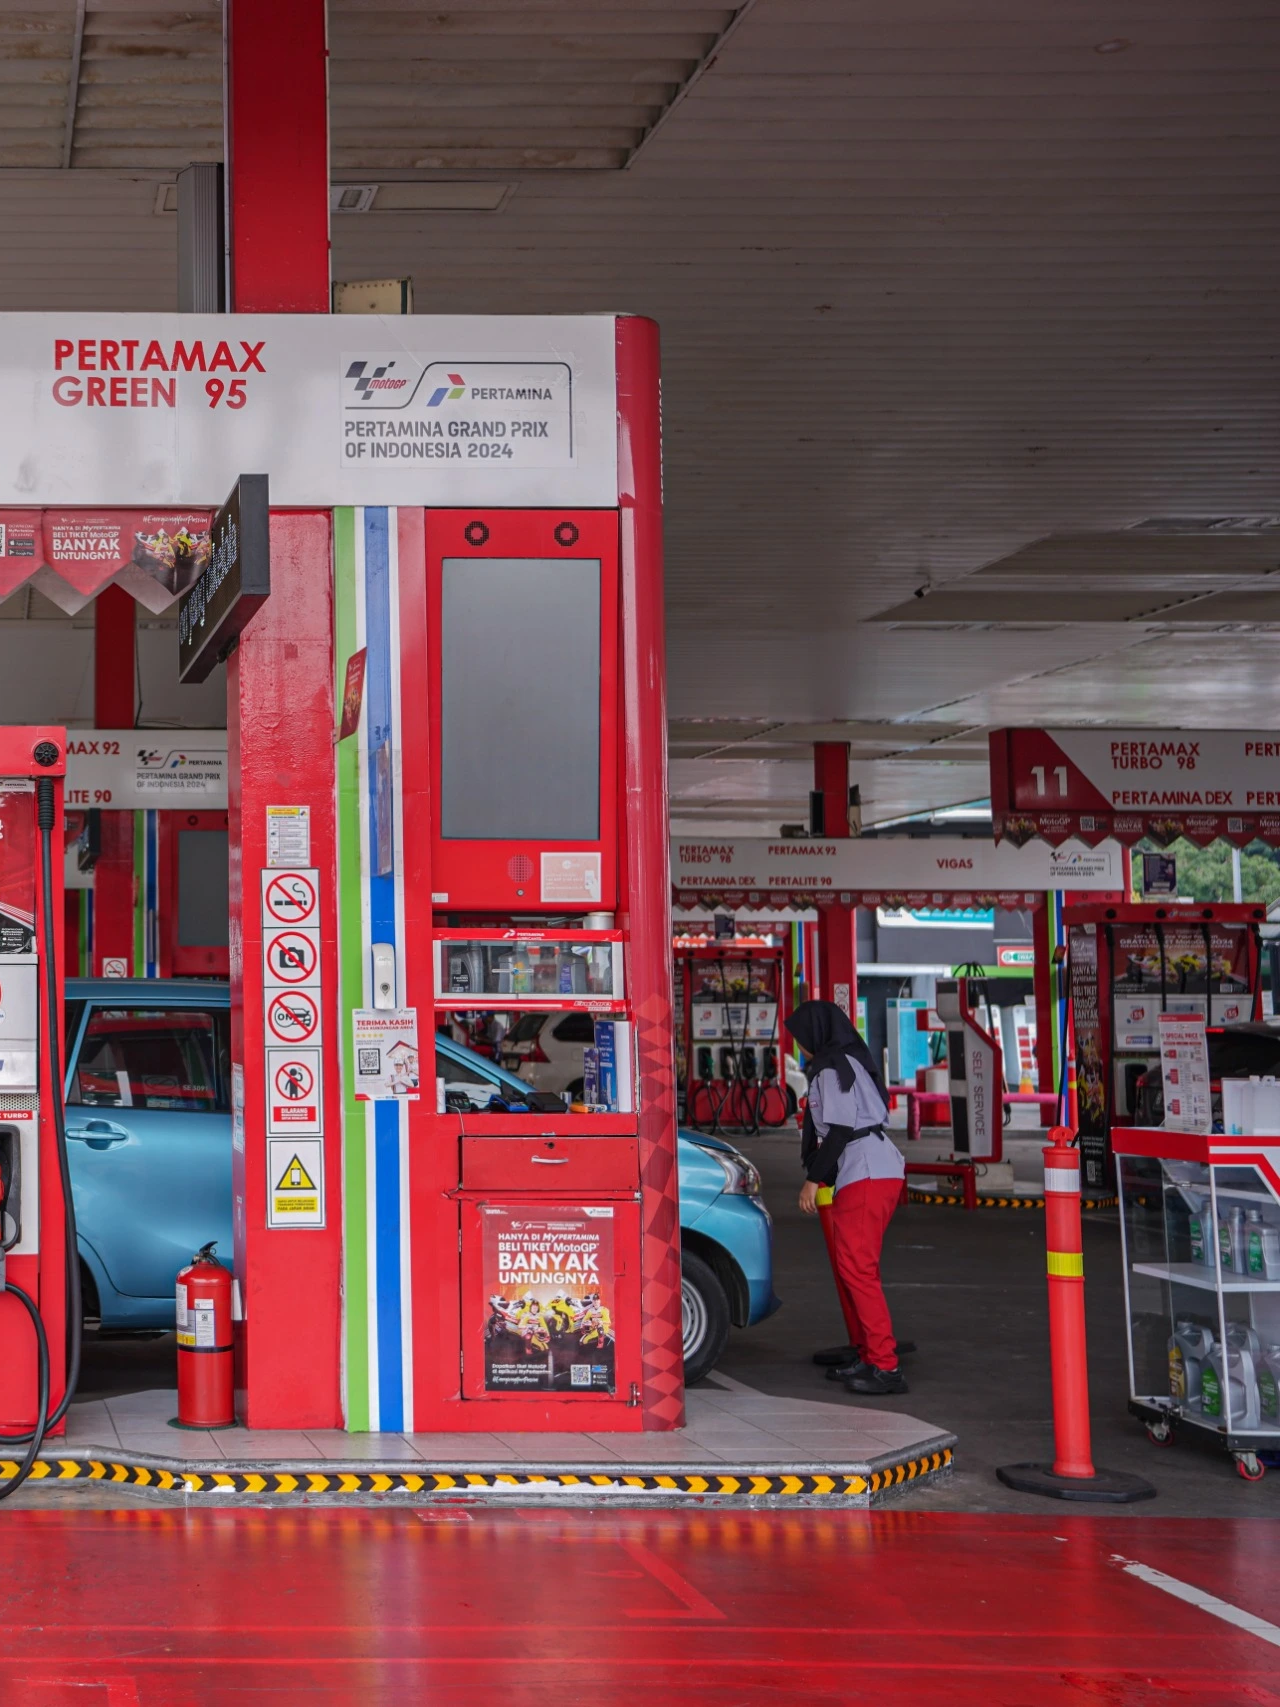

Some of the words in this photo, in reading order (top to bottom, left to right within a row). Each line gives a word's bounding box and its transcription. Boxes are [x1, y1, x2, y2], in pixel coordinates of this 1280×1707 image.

[54, 339, 266, 373] PERTAMAX
[52, 376, 176, 409] GREEN
[204, 377, 247, 410] 95
[471, 388, 553, 400] PERTAMINA
[345, 421, 444, 437] PERTAMINA
[448, 421, 506, 437] GRAND
[511, 421, 549, 437] PRIX
[345, 442, 366, 459] OF
[371, 442, 462, 459] INDONESIA
[467, 443, 514, 459] 2024
[53, 539, 120, 550] BANYAK
[53, 551, 120, 560] UNTUNGNYA
[103, 742, 120, 755] 92
[1111, 742, 1200, 756] PERTAMAX
[1112, 756, 1162, 769] TURBO
[1177, 756, 1196, 769] 98
[1030, 766, 1068, 796] 11
[94, 790, 112, 803] 90
[1112, 791, 1202, 805] PERTAMINA
[1205, 791, 1233, 805] DEX
[679, 845, 734, 855] PERTAMAX
[768, 846, 823, 855] PERTAMAX
[825, 846, 837, 855] 92
[680, 854, 711, 863] TURBO
[720, 854, 732, 863] 98
[937, 858, 973, 869] VIGAS
[681, 876, 736, 886] PERTAMINA
[738, 876, 756, 886] DEX
[769, 876, 819, 886] PERTALITE
[821, 876, 832, 886] 90
[972, 1051, 983, 1080] SELF
[974, 1086, 985, 1136] SERVICE
[498, 1233, 529, 1241] HANYA
[532, 1233, 540, 1241] DI
[542, 1233, 600, 1243] MyPERTAMINA
[498, 1243, 521, 1251] BELI
[522, 1243, 551, 1251] TIKET
[498, 1253, 599, 1271] BANYAK
[499, 1272, 599, 1285] UNTUNGNYA
